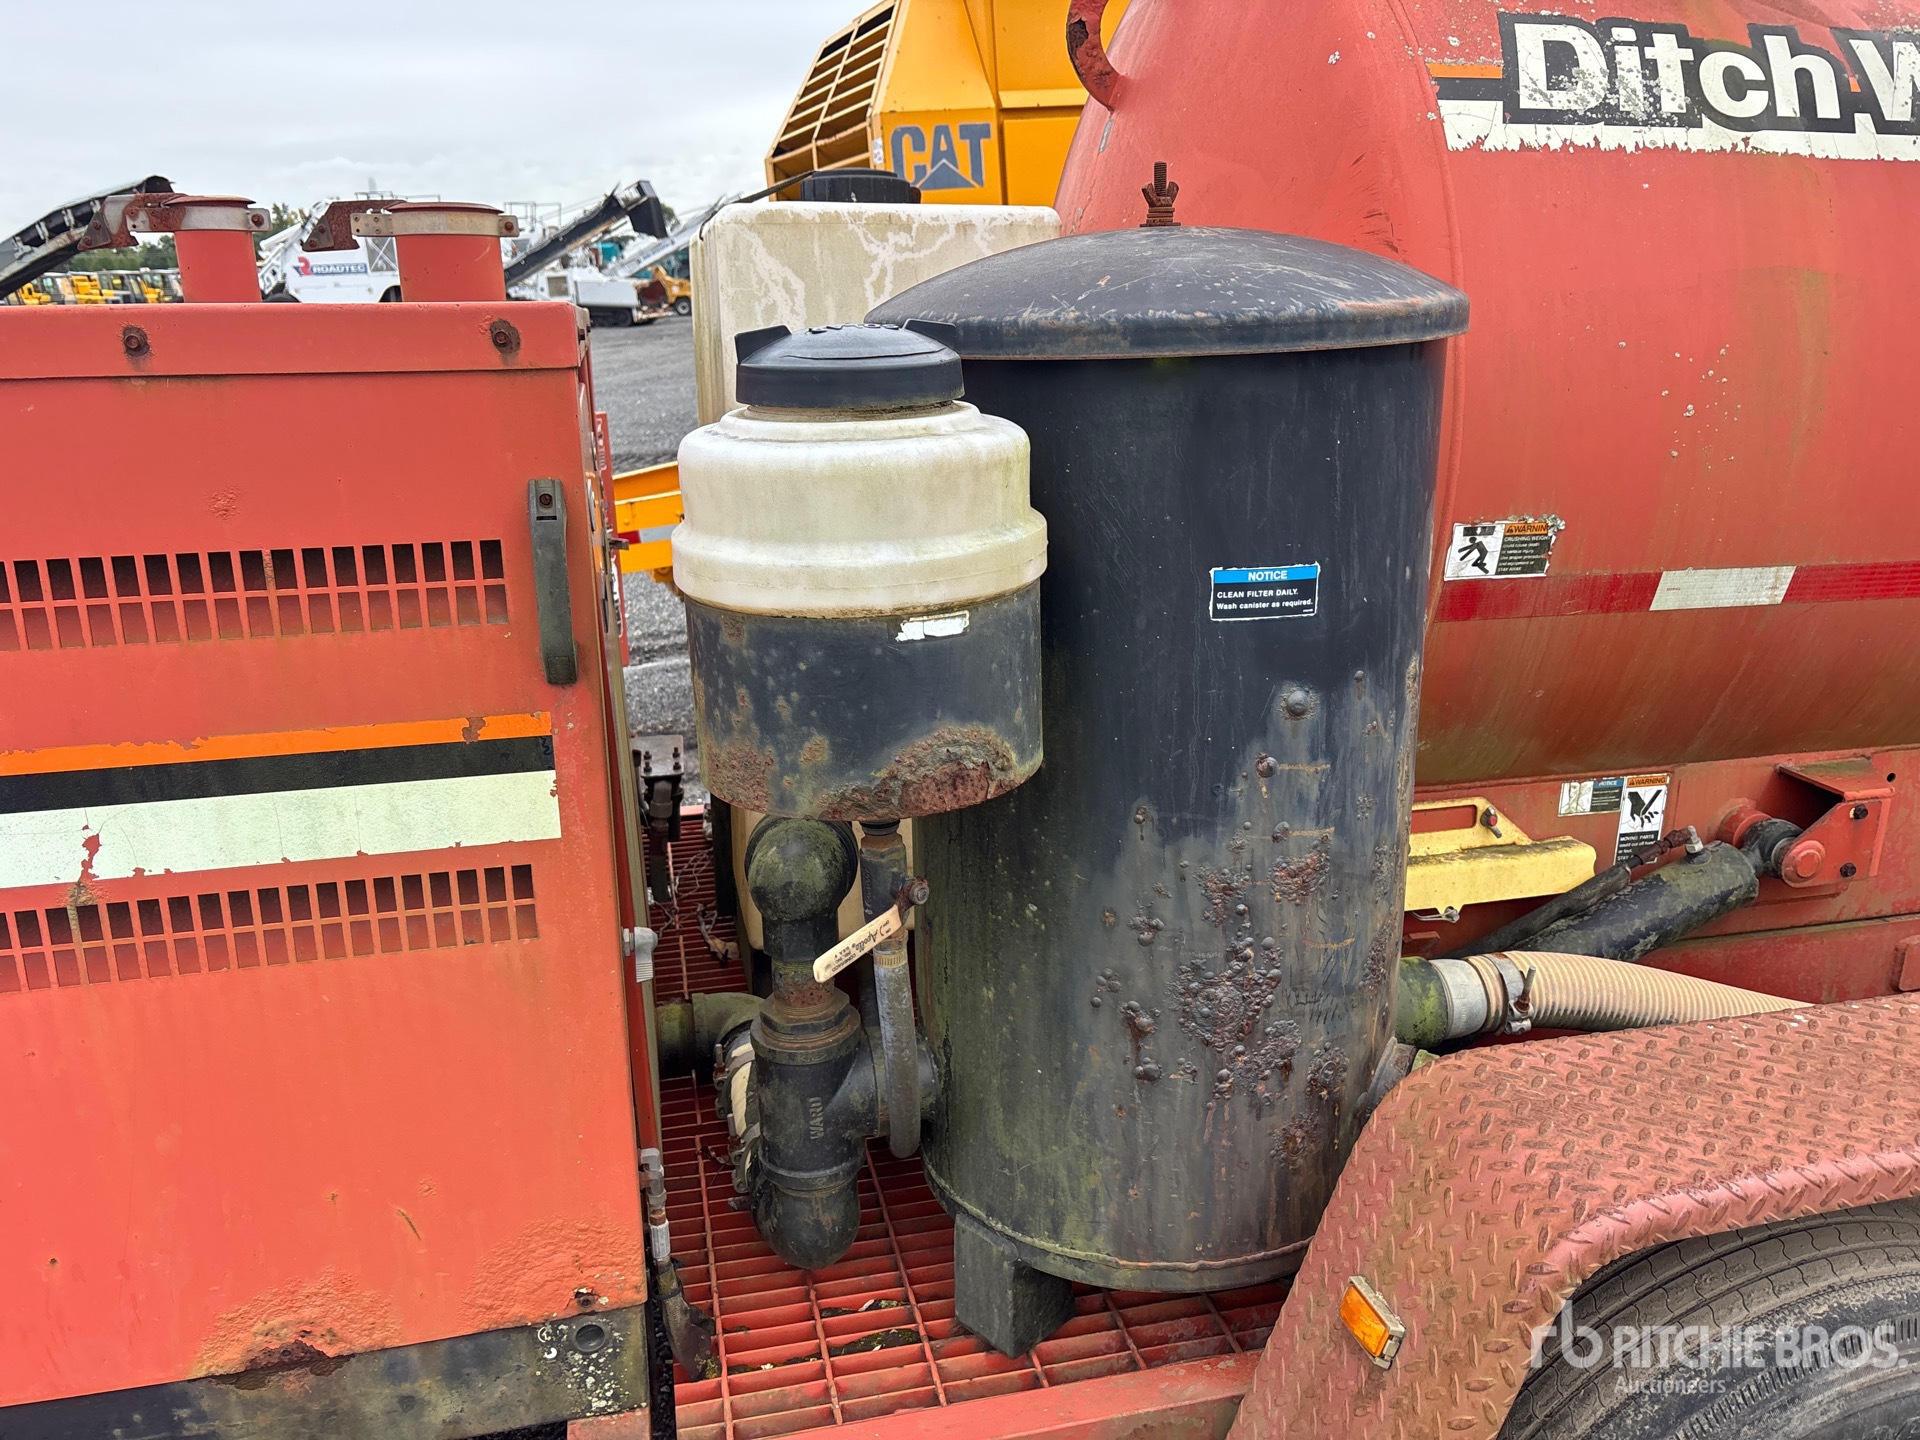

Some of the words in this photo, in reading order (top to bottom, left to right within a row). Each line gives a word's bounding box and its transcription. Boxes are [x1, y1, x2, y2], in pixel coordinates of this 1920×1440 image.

[1513, 22, 1841, 119] Ditch
[889, 122, 992, 189] CAT
[1248, 570, 1288, 581] NOTICE
[1217, 591, 1245, 599] CLEAN
[1247, 589, 1274, 598] FILTER
[1276, 588, 1299, 597] DAILY.
[1216, 602, 1237, 610] Wash
[1239, 601, 1269, 609] canister
[1282, 598, 1313, 608] required.
[1635, 777, 1666, 785] WARNING
[809, 1096, 825, 1140] WARD
